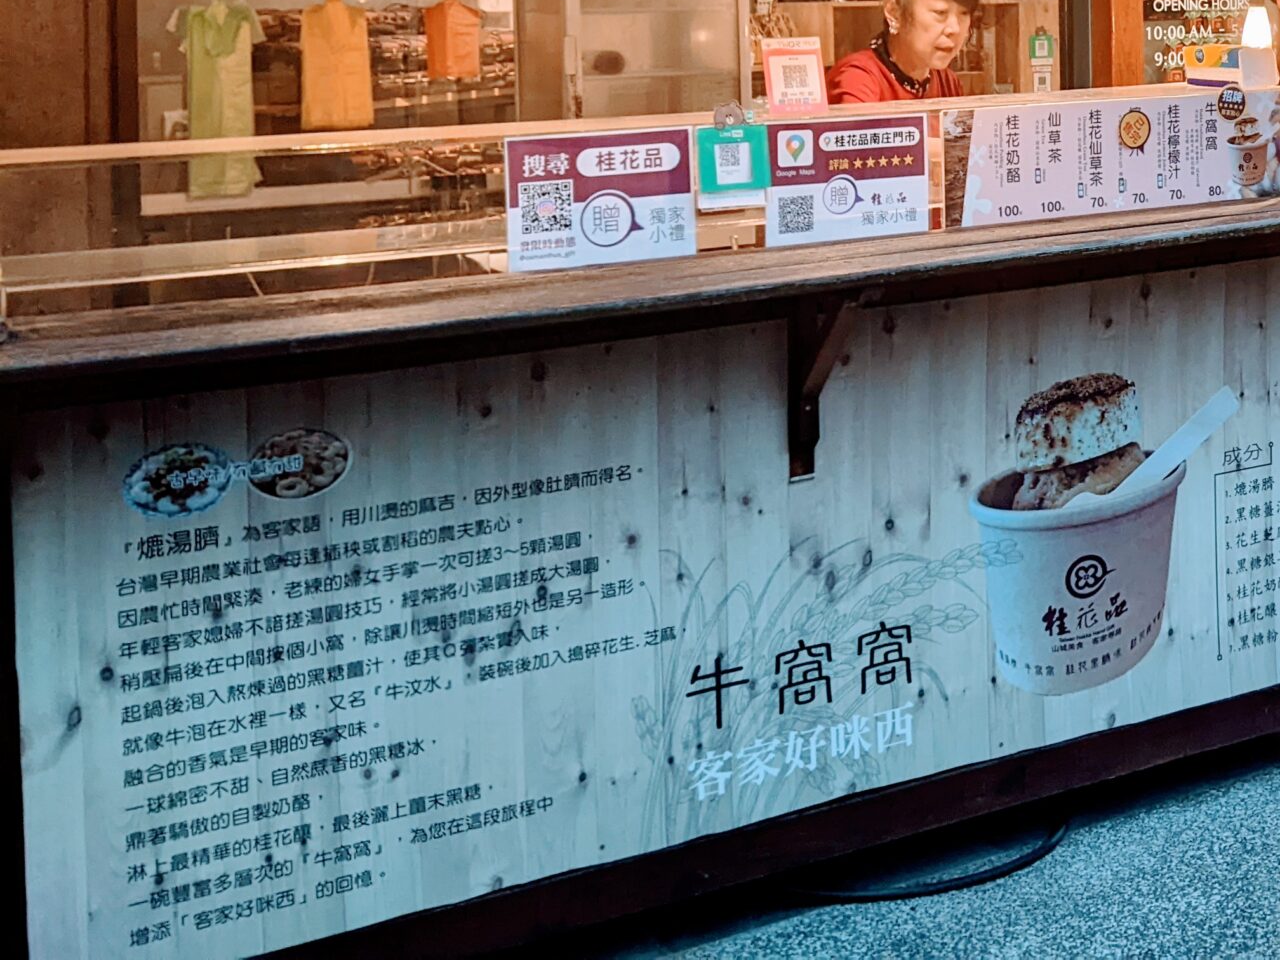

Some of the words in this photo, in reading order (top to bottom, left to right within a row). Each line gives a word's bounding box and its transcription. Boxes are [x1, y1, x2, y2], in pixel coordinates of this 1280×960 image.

[1146, 25, 1185, 40] 10:00
[1189, 25, 1213, 40] AM
[834, 129, 916, 147] 桂花品南庄門市
[1048, 112, 1062, 163] 仙草茶
[1205, 102, 1217, 150] 牛窩窩
[1005, 115, 1020, 183] 桂花奶酪
[1089, 109, 1103, 187] 桂花仙草茶
[1168, 104, 1180, 179] 桂花檸檬汁
[522, 153, 570, 177] 搜尋
[595, 148, 663, 172] 桂花品
[829, 158, 849, 170] 評論
[776, 169, 797, 177] Google
[799, 168, 815, 176] Maps
[830, 186, 849, 207] 贈
[592, 203, 620, 235] 贈
[649, 206, 685, 226] 獨家
[861, 207, 918, 227] 獨家小禮
[649, 225, 686, 243] 小禮
[1222, 442, 1263, 467] 成分
[1042, 592, 1129, 636] 桂花品
[686, 621, 912, 729] 牛窩窩
[688, 701, 914, 801] 客家好咪西
